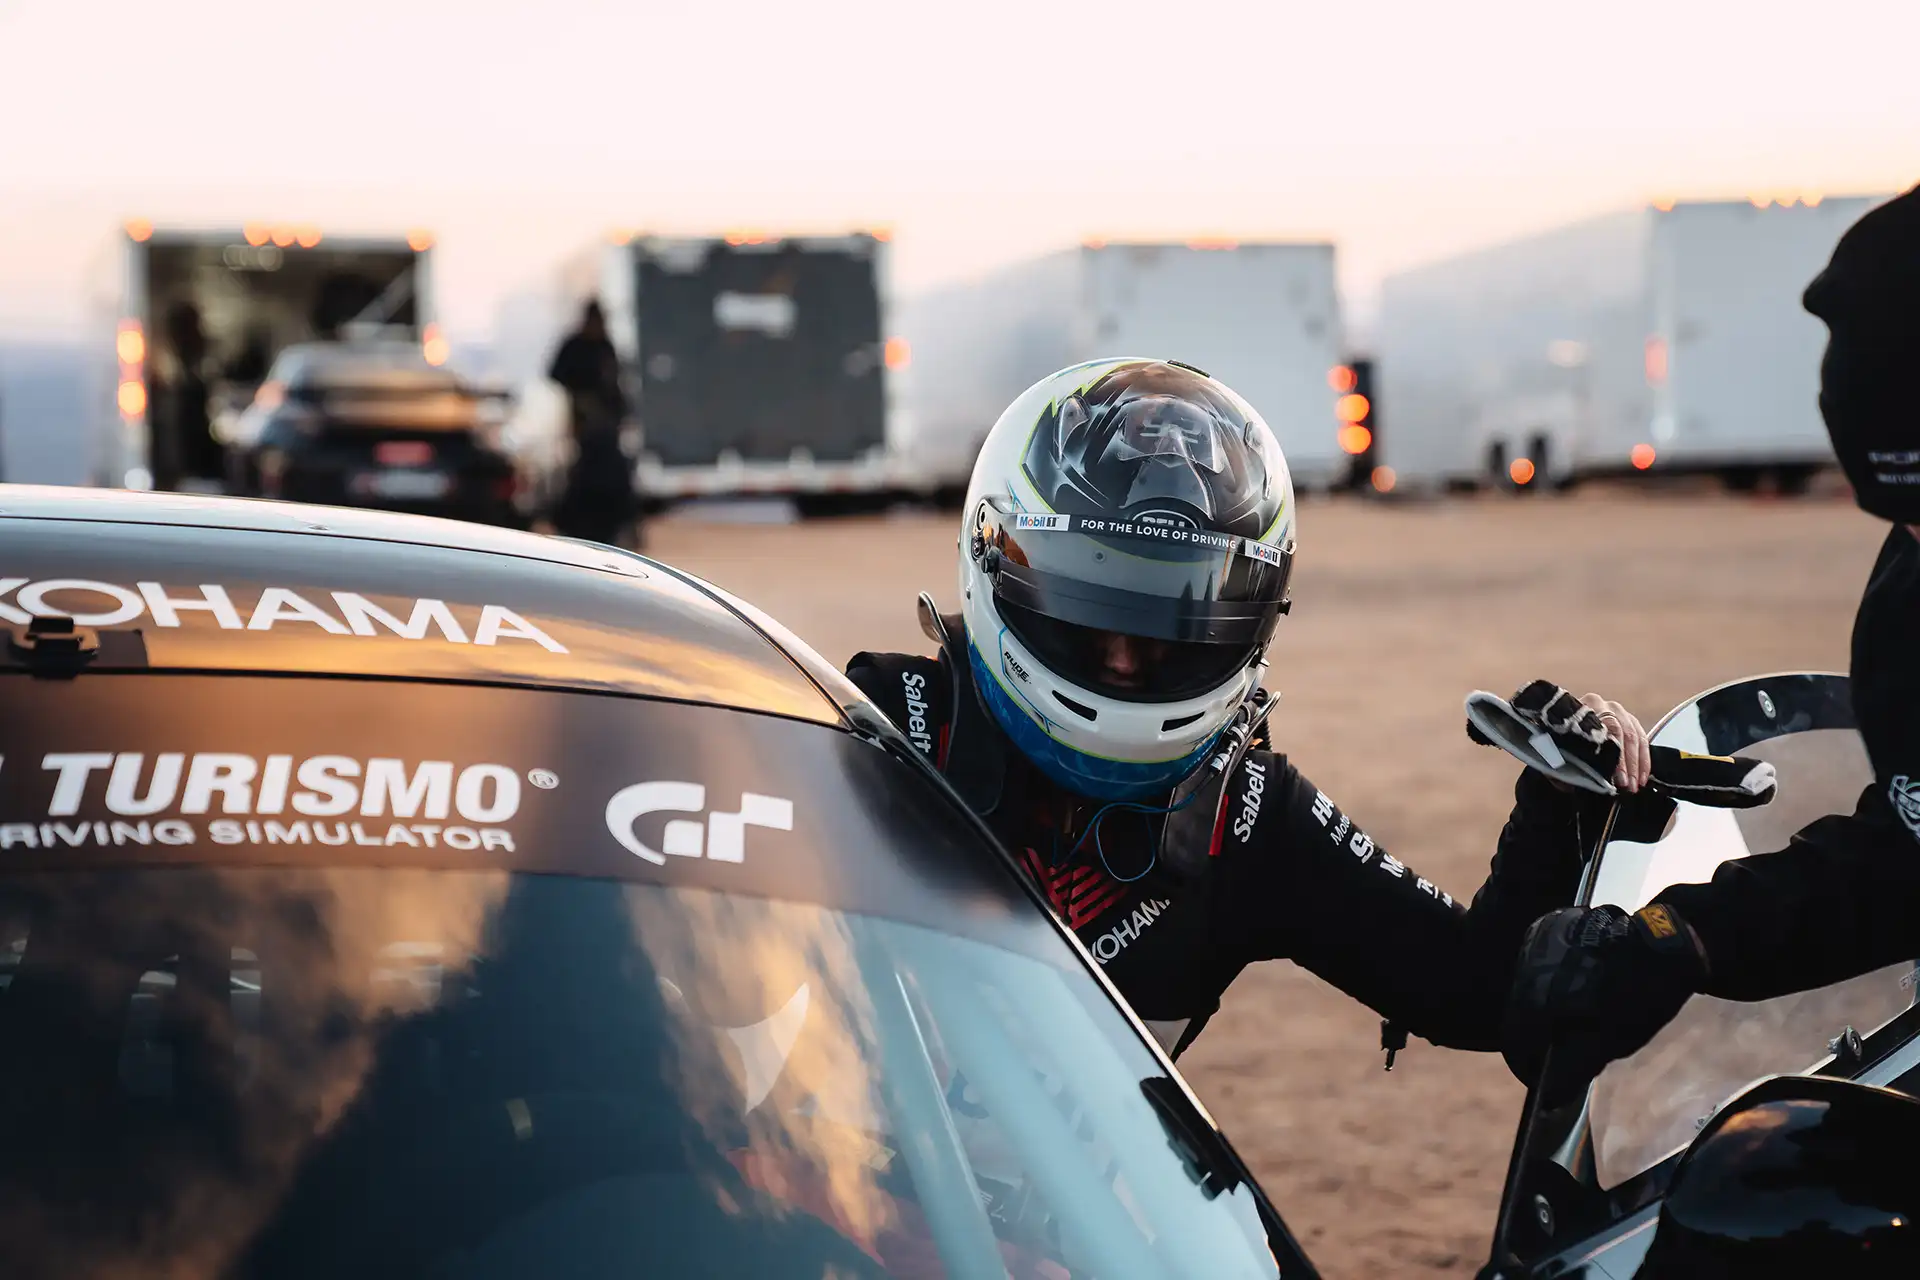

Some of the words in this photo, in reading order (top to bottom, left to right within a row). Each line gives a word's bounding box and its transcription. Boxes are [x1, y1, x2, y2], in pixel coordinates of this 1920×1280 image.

[1019, 516, 1046, 527] Mobil
[1080, 519, 1105, 532] FOR
[1108, 521, 1133, 535] THE
[1136, 525, 1168, 539] LOVE
[1172, 530, 1189, 542] OF
[1191, 533, 1237, 549] DRIVING
[1252, 545, 1272, 561] Mobil
[901, 671, 932, 754] Sabelt
[1234, 759, 1267, 842] Sabelt
[210, 819, 516, 854] SIMULATOR
[1090, 897, 1171, 965] KOHAM
